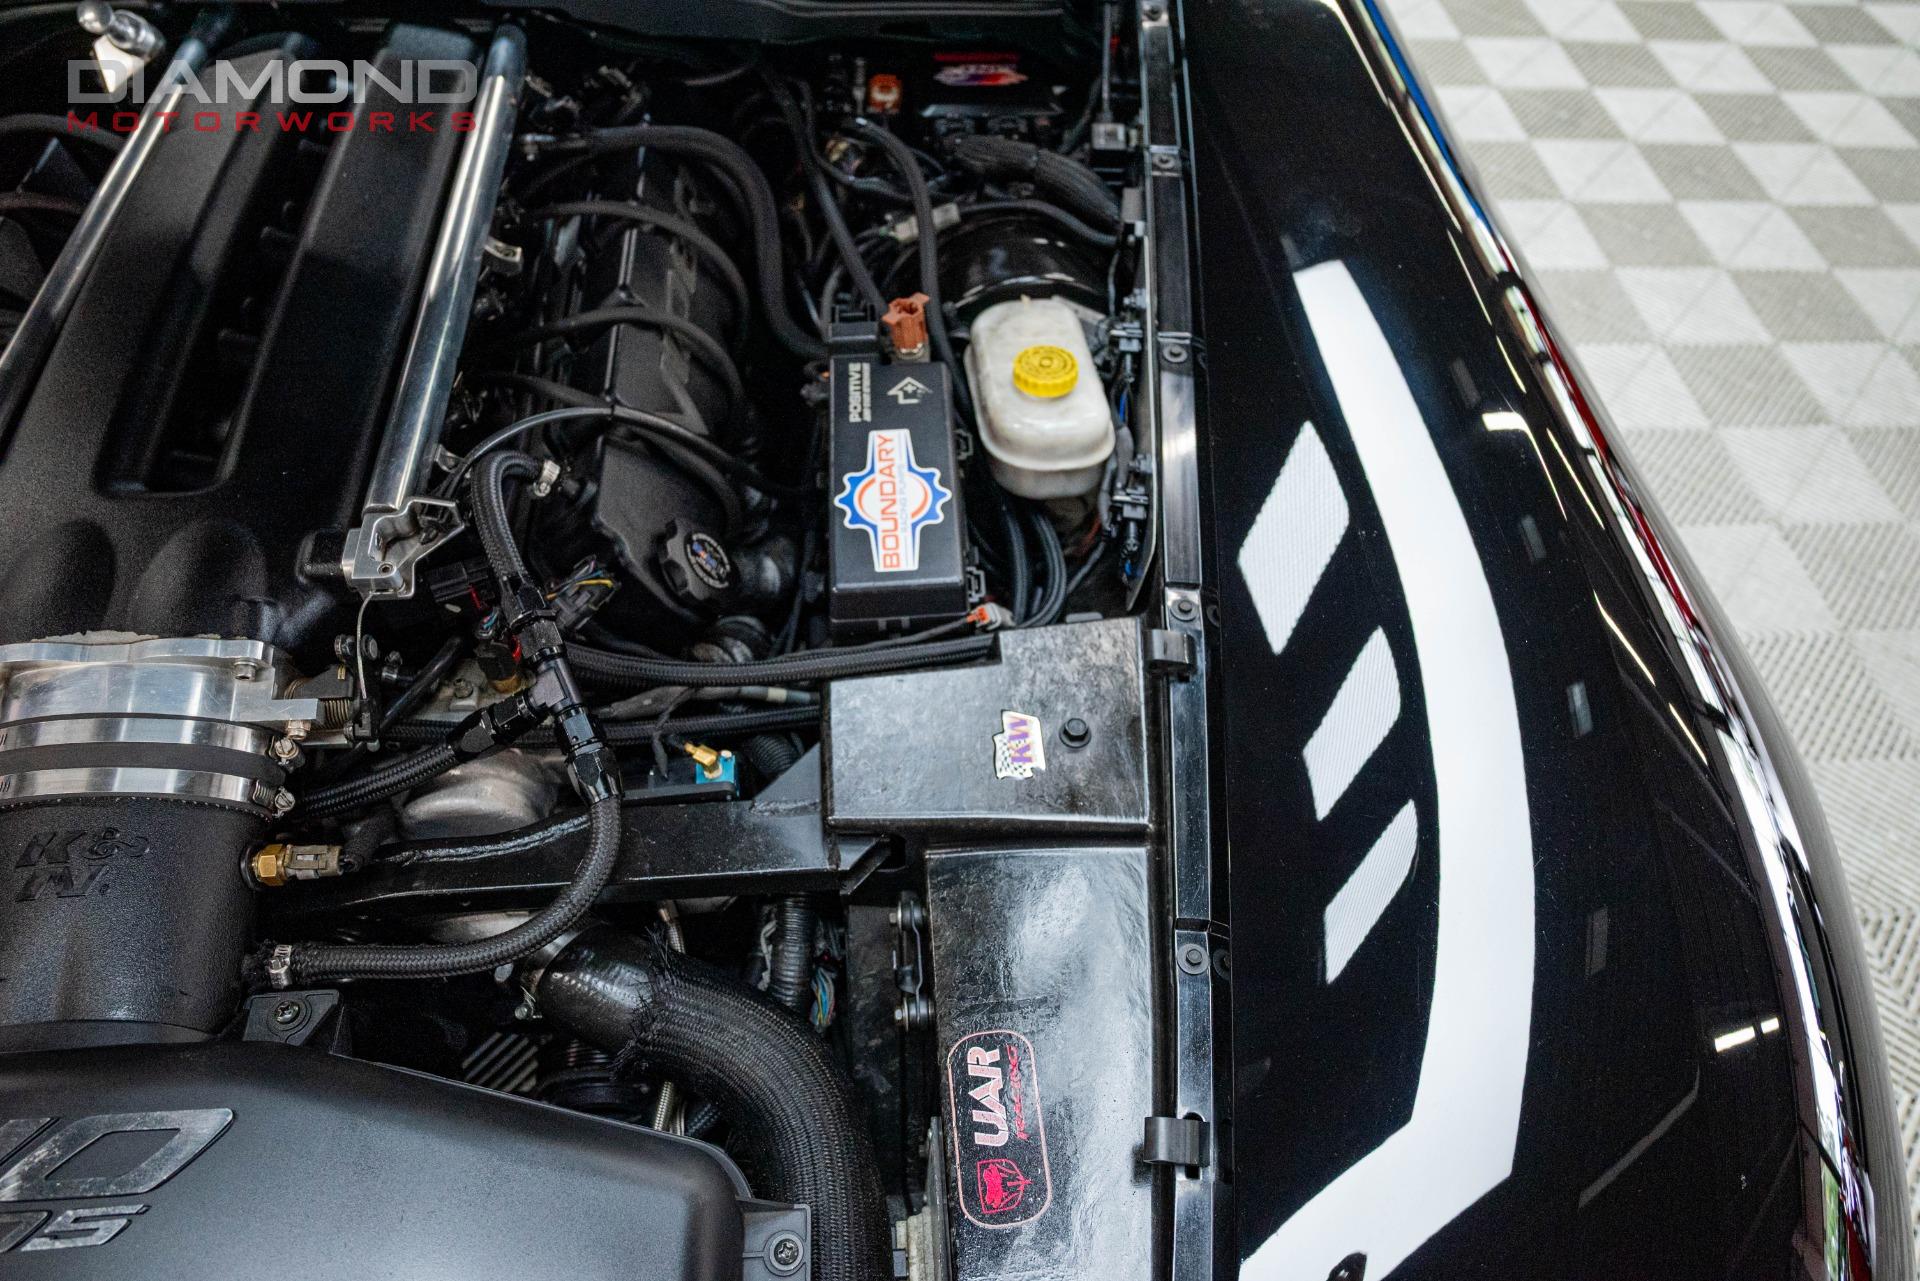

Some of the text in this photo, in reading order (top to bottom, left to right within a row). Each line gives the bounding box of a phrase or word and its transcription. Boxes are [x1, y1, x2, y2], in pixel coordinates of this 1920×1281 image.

[848, 362, 862, 422] POSITIVE
[877, 434, 900, 568] BOUNDARY
[967, 1046, 1009, 1147] UAR
